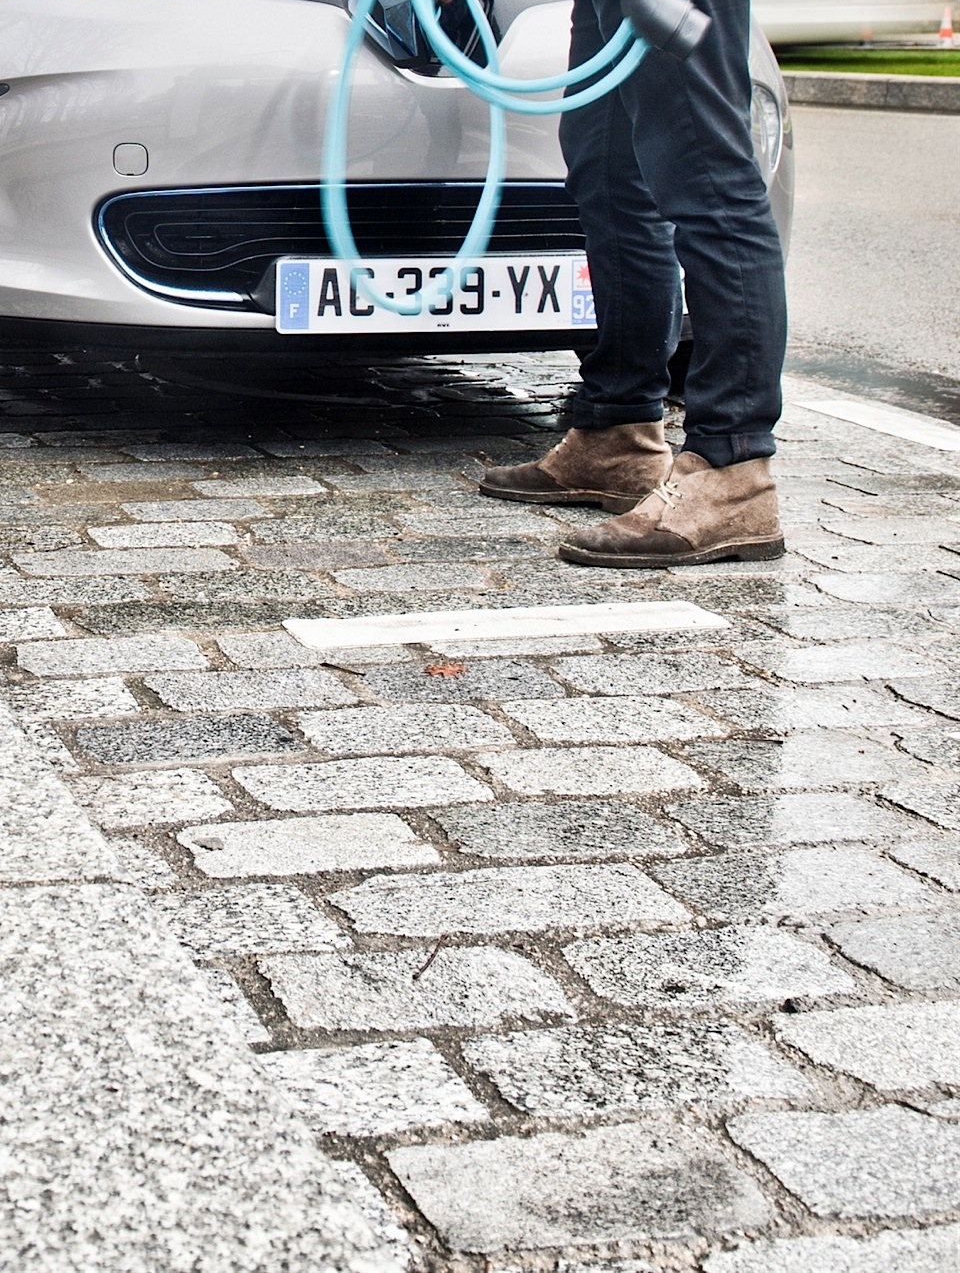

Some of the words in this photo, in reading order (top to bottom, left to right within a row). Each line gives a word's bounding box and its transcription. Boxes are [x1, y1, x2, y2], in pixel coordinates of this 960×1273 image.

[317, 265, 561, 317] AC-339-YX
[289, 303, 300, 319] F
[573, 295, 597, 320] 92
